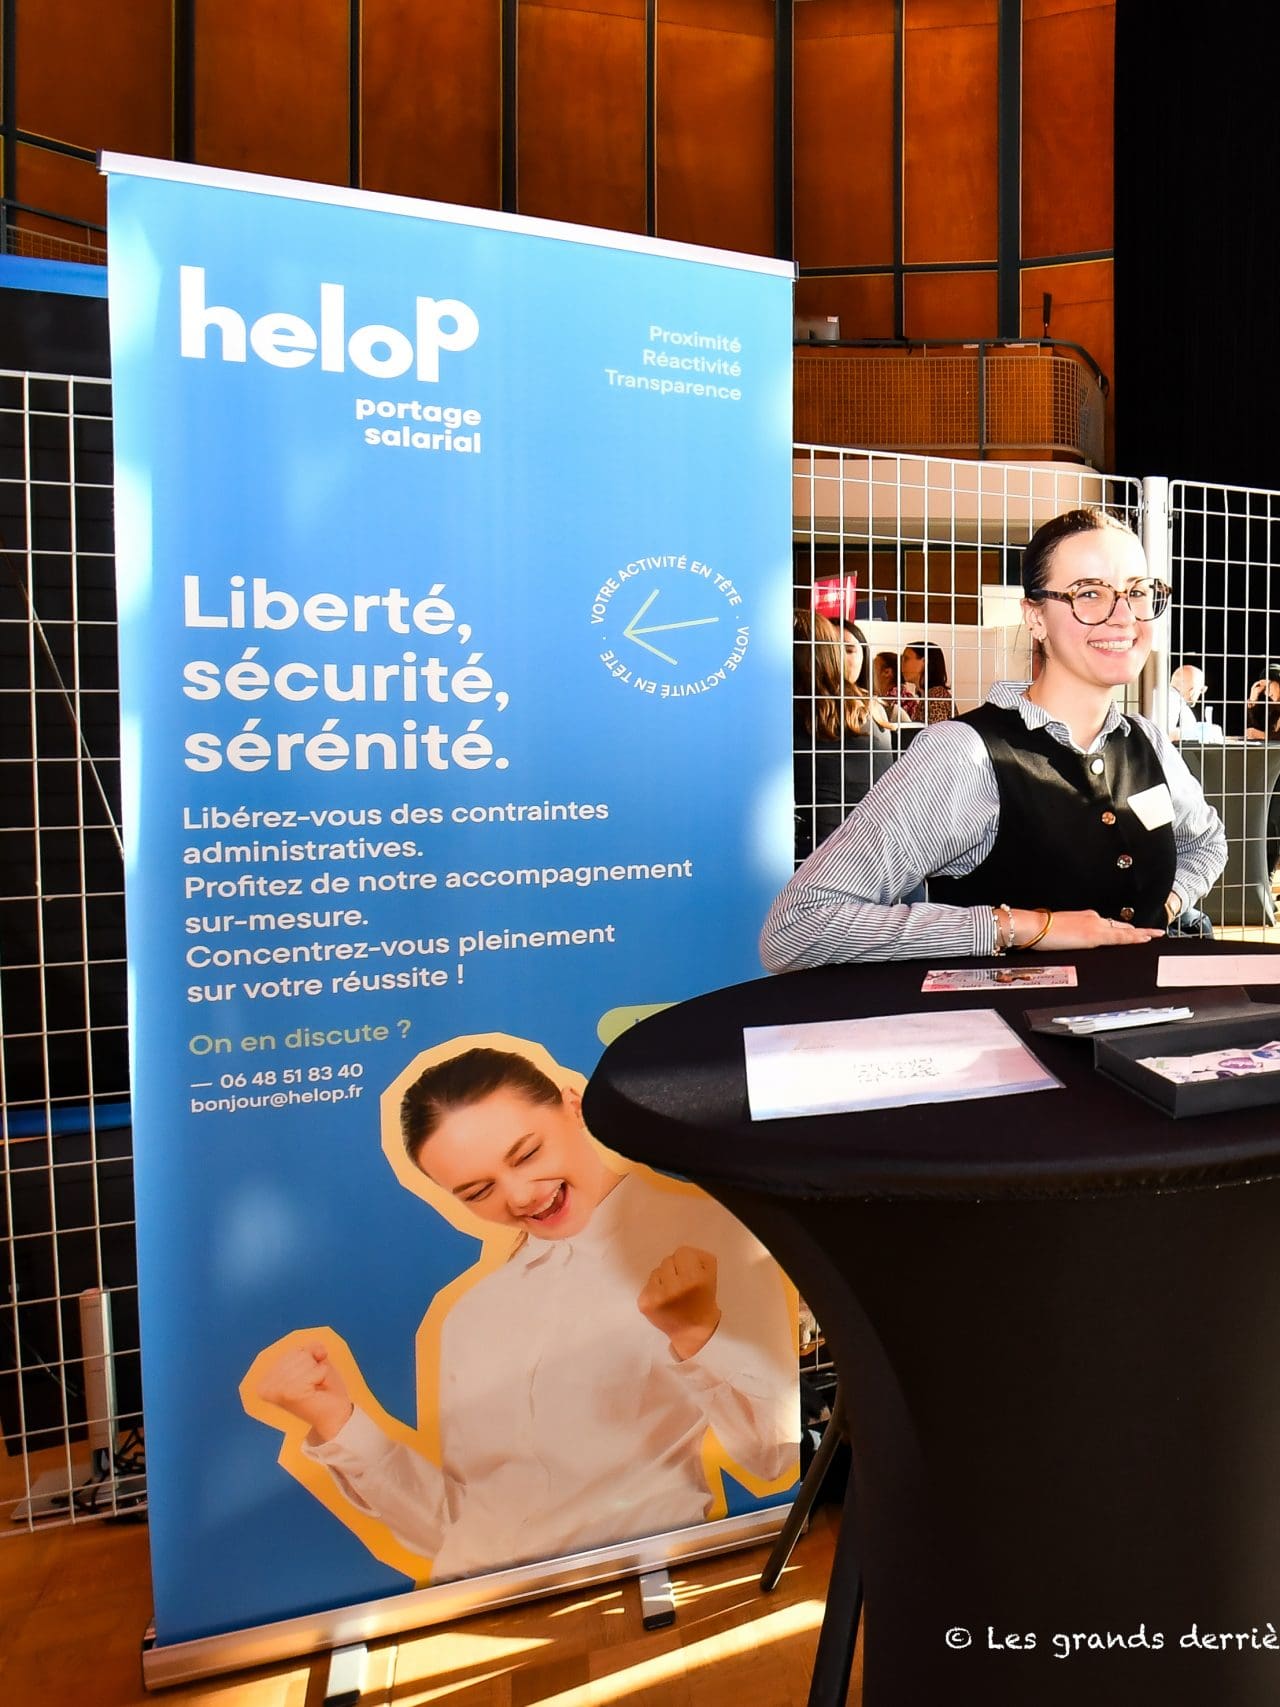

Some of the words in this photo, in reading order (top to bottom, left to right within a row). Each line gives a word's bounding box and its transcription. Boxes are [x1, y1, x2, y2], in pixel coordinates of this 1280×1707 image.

[648, 325, 742, 354] Proximité
[643, 349, 742, 377] Réactivité
[604, 368, 742, 401] Transparence
[355, 398, 482, 429] portage
[364, 425, 481, 454] salarial
[590, 577, 620, 624] VOTRE
[618, 554, 688, 582] ACTIVITÉ
[690, 560, 713, 578] EN
[713, 573, 742, 606] TÊTE
[184, 575, 472, 645] Liberté,
[723, 626, 750, 672] VOTRE
[182, 646, 510, 712] sécurité,
[599, 650, 633, 684] TÊTE
[633, 677, 657, 694] EN
[660, 668, 727, 699] ACTIVITÉ
[184, 718, 510, 772] sérénité.
[183, 805, 382, 830] Libérez-vous
[390, 803, 444, 825] des
[451, 800, 609, 823] contraintes
[183, 837, 424, 865] administratives.
[185, 874, 303, 899] Profitez
[310, 872, 350, 895] de
[359, 871, 438, 892] notre
[445, 859, 693, 889] accompagnement
[185, 909, 369, 934] sur-mesure.
[186, 937, 450, 969] Concentrez-vous
[459, 924, 615, 957] pleinement
[187, 983, 237, 1003] sur
[243, 977, 323, 999] votre
[332, 966, 449, 994] réussite
[188, 1034, 232, 1056] On
[240, 1035, 276, 1052] en
[284, 1024, 389, 1049] discute
[396, 1019, 412, 1039] ?
[220, 1072, 247, 1089] 06
[251, 1070, 277, 1086] 48
[282, 1068, 302, 1084] 51
[307, 1066, 333, 1082] 83
[337, 1063, 364, 1079] 40
[190, 1085, 364, 1113] bonjour@helop.fr
